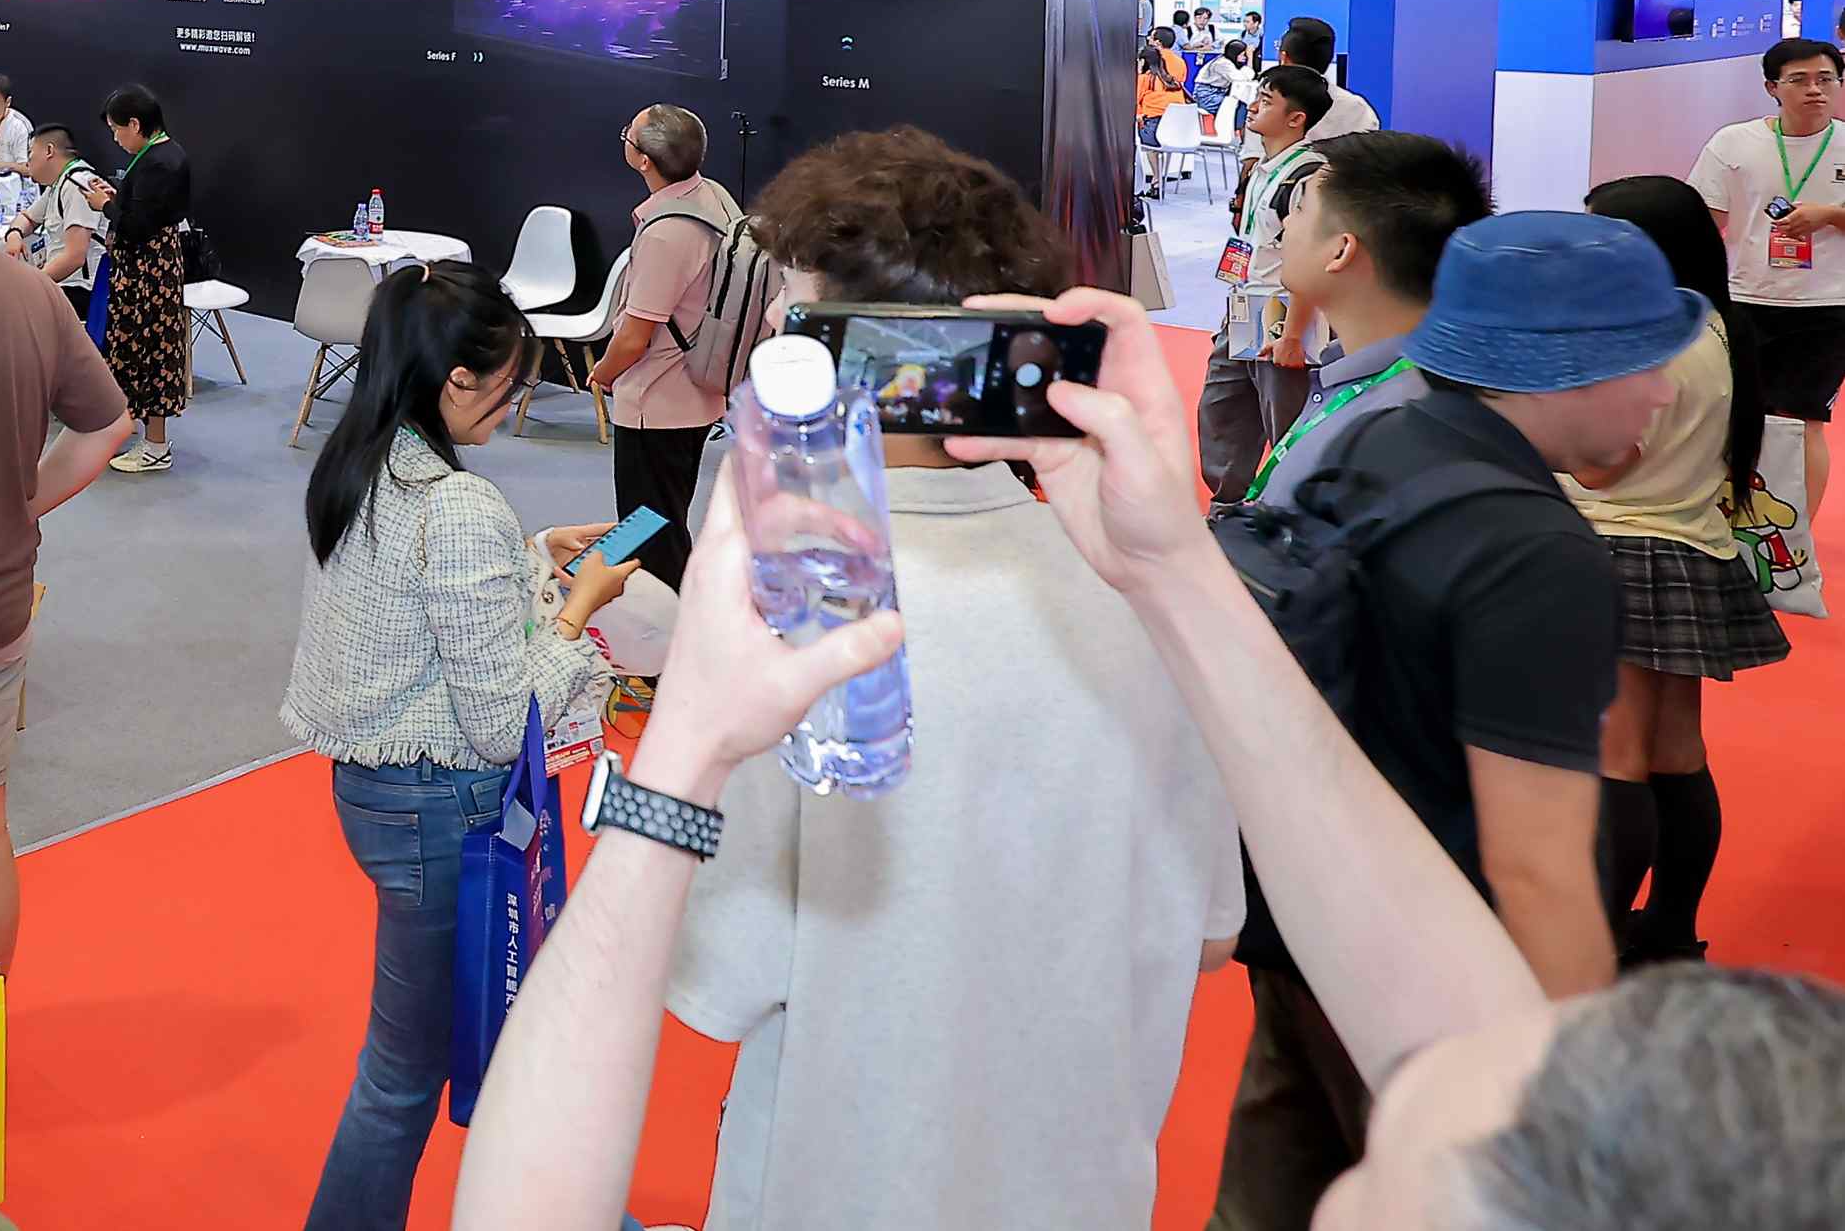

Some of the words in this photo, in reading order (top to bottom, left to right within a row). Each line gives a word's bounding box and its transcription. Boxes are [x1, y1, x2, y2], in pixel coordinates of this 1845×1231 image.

[180, 43, 251, 55] www.muxwave.com
[426, 50, 450, 61] Series
[451, 52, 457, 61] F
[822, 75, 856, 89] Series
[858, 77, 870, 89] M
